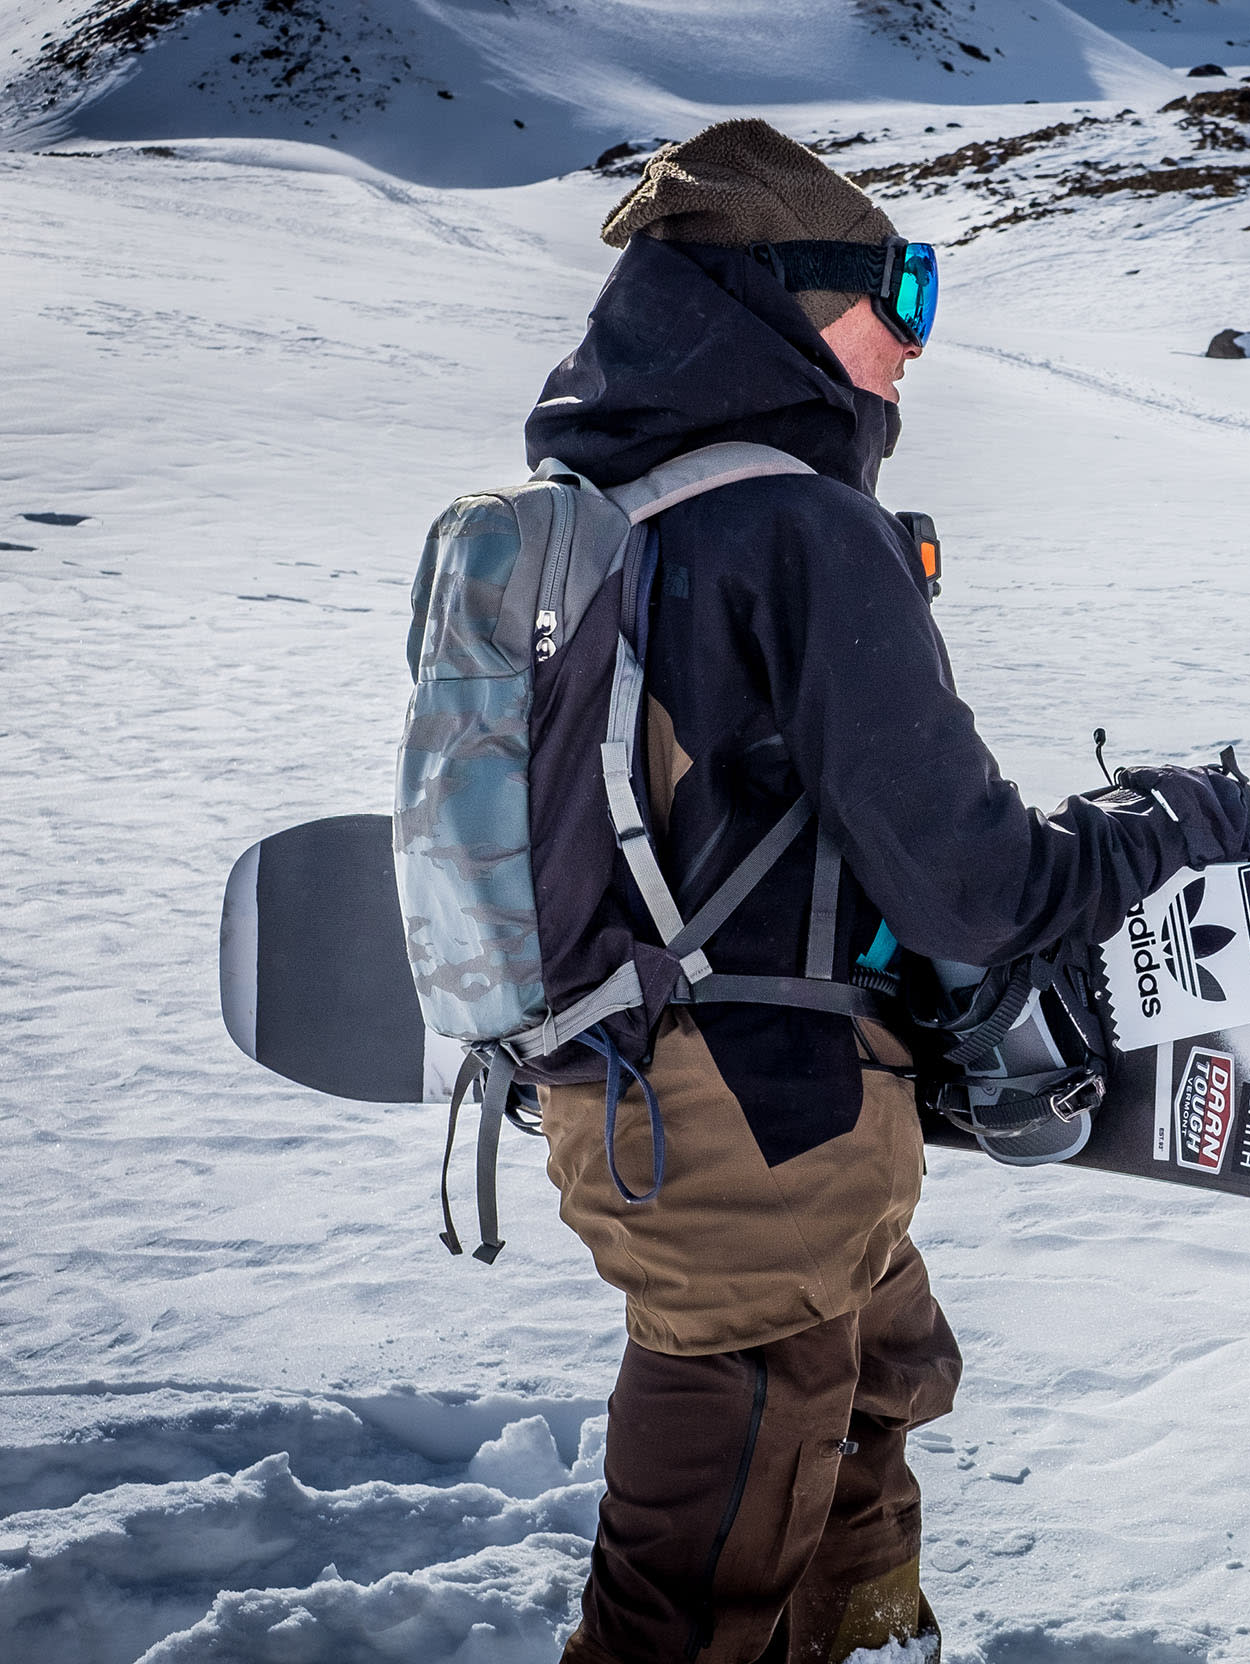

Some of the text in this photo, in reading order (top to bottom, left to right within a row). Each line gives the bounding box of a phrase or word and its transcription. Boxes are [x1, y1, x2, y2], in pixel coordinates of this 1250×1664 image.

[1181, 1077, 1194, 1137] VERMONT
[1186, 1061, 1211, 1154] TOUGH
[1202, 1065, 1229, 1162] DARN
